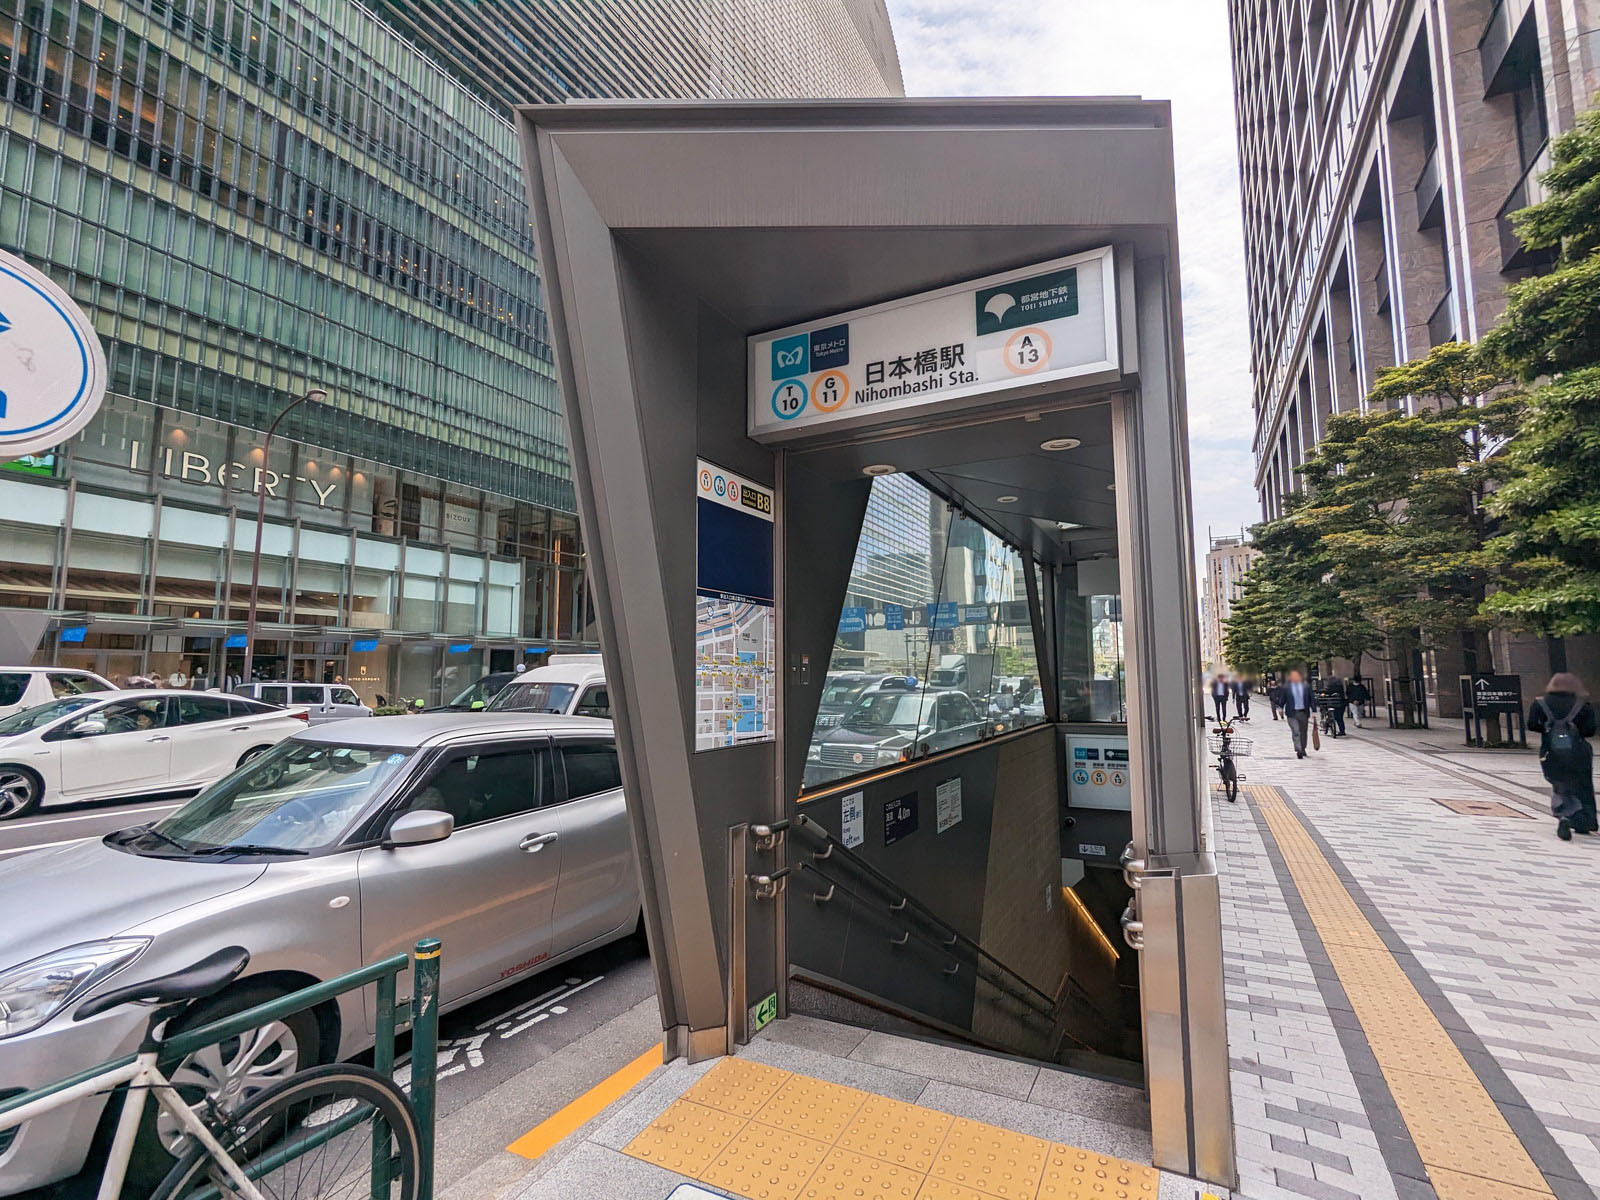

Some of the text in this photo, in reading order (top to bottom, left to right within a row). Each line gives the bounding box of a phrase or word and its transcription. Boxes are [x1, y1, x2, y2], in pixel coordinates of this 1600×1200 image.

[1021, 285, 1068, 303] 都営地下鉄
[1021, 295, 1068, 312] TOEI SUBWAY
[813, 338, 846, 352] 東京メトロ
[1021, 336, 1034, 349] A
[815, 347, 844, 358] Tokyo Metro
[1018, 349, 1039, 365] 13
[866, 343, 965, 386] 日本橋駅
[825, 377, 836, 389] G
[855, 370, 979, 404] Nihombashi Sta.
[786, 386, 793, 397] T
[822, 389, 837, 403] 11
[782, 398, 799, 411] 10
[703, 479, 709, 487] 11
[717, 485, 723, 493] 10
[757, 493, 770, 512] B8
[501, 952, 548, 978] YOSHIDA
